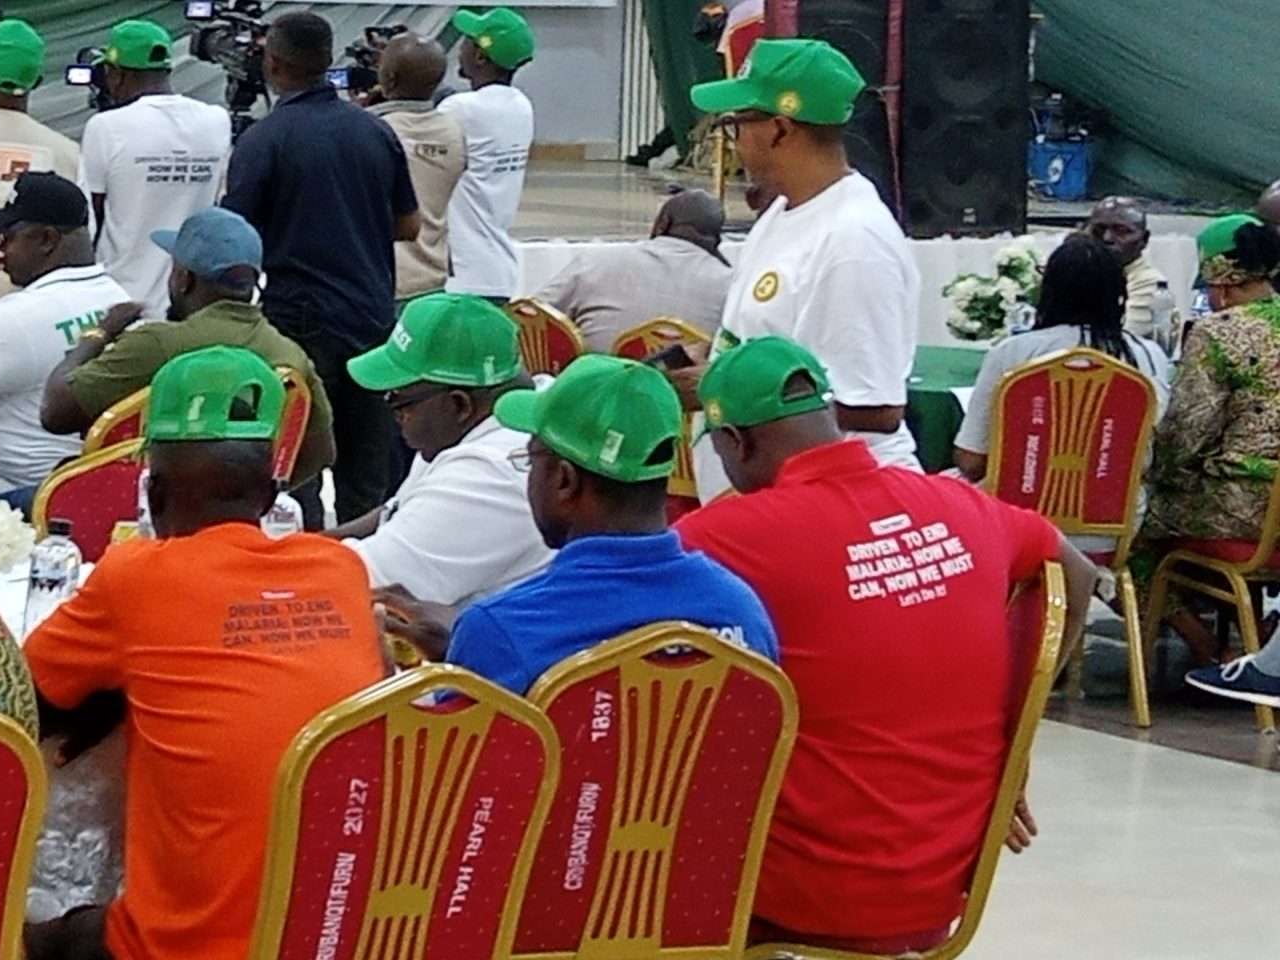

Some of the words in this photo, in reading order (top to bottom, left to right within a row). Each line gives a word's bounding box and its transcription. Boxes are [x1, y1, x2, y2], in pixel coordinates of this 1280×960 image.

[846, 538, 900, 562] DRIVEN
[900, 530, 923, 549] TO
[911, 543, 945, 566] NOW
[884, 571, 919, 593] NOW
[916, 564, 942, 584] WE
[286, 601, 303, 614] TO
[592, 690, 613, 742] 1837
[344, 778, 369, 836] 2027
[466, 795, 493, 860] PEARL
[447, 861, 474, 919] HALL
